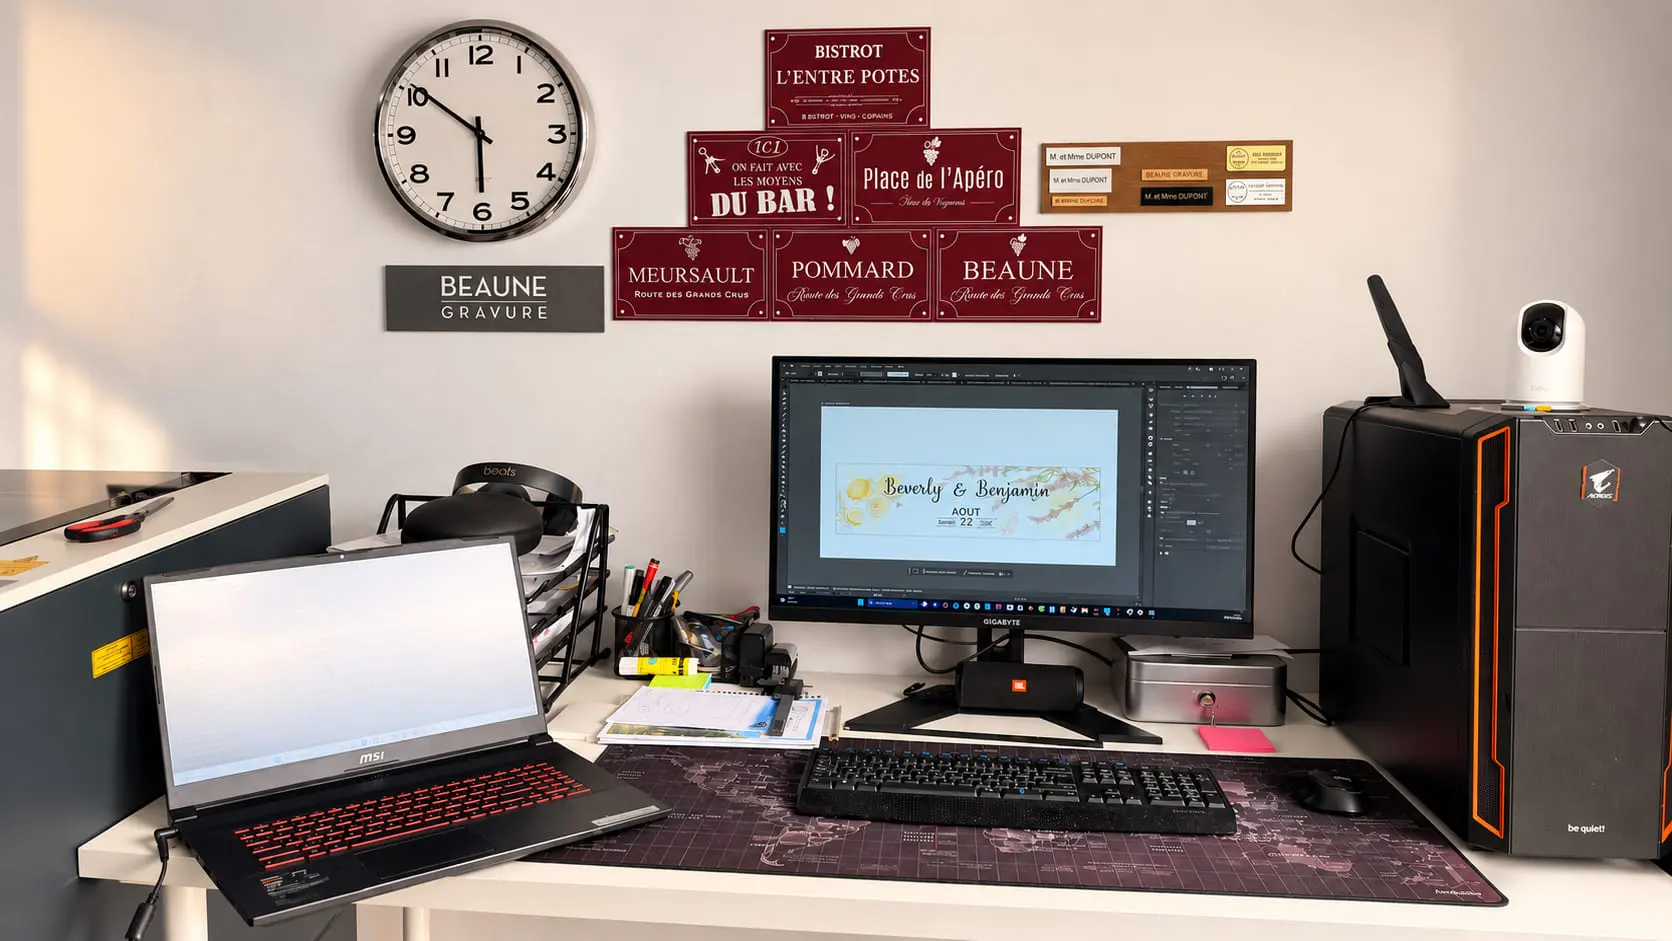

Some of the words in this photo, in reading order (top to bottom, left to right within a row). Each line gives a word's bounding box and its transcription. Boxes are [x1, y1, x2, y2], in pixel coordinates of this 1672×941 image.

[468, 45, 494, 65] 12
[815, 44, 883, 59] BISTROT
[435, 58, 449, 78] 11
[516, 55, 522, 75] 1
[776, 69, 855, 85] L'ENTRE
[861, 68, 920, 84] POTES
[407, 86, 429, 107] 10
[537, 83, 556, 104] 2
[396, 126, 416, 145] 9
[548, 124, 567, 144] 3
[754, 140, 781, 154] ICI
[1085, 152, 1116, 160] DUPONT
[410, 164, 429, 183] 8
[536, 162, 556, 182] 4
[731, 162, 747, 172] ON
[750, 162, 773, 172] FAIT
[776, 162, 803, 172] AVEC
[733, 176, 753, 187] LES
[757, 176, 803, 186] MOYENS
[864, 167, 909, 190] Place
[916, 170, 933, 189] de
[941, 165, 1004, 192] l'Apéro
[1081, 176, 1108, 184] DUPONT
[436, 192, 455, 212] 7
[510, 191, 530, 211] 5
[710, 191, 747, 217] DU
[756, 187, 817, 215] BAR
[826, 185, 835, 211] !
[1178, 192, 1208, 200] DUPONT
[472, 203, 492, 221] 6
[628, 267, 755, 284] MEURSAULT
[792, 260, 914, 279] POMMARD
[963, 260, 1074, 281] BEAUNE
[440, 275, 547, 297] BEAUNE
[786, 286, 823, 302] Route
[825, 288, 840, 299] des
[889, 286, 917, 301] Crus
[950, 286, 989, 302] Route
[990, 288, 1005, 299] des
[441, 306, 548, 319] GRAVURE
[483, 466, 517, 477] beats
[884, 476, 943, 503] Beverly
[953, 482, 967, 497] &
[976, 479, 1049, 504] Benjamin
[951, 507, 981, 516] AOUT
[960, 517, 973, 527] 22
[983, 618, 1021, 626] GIGABYTE
[1567, 824, 1579, 833] be
[1580, 824, 1605, 834] quiet!
